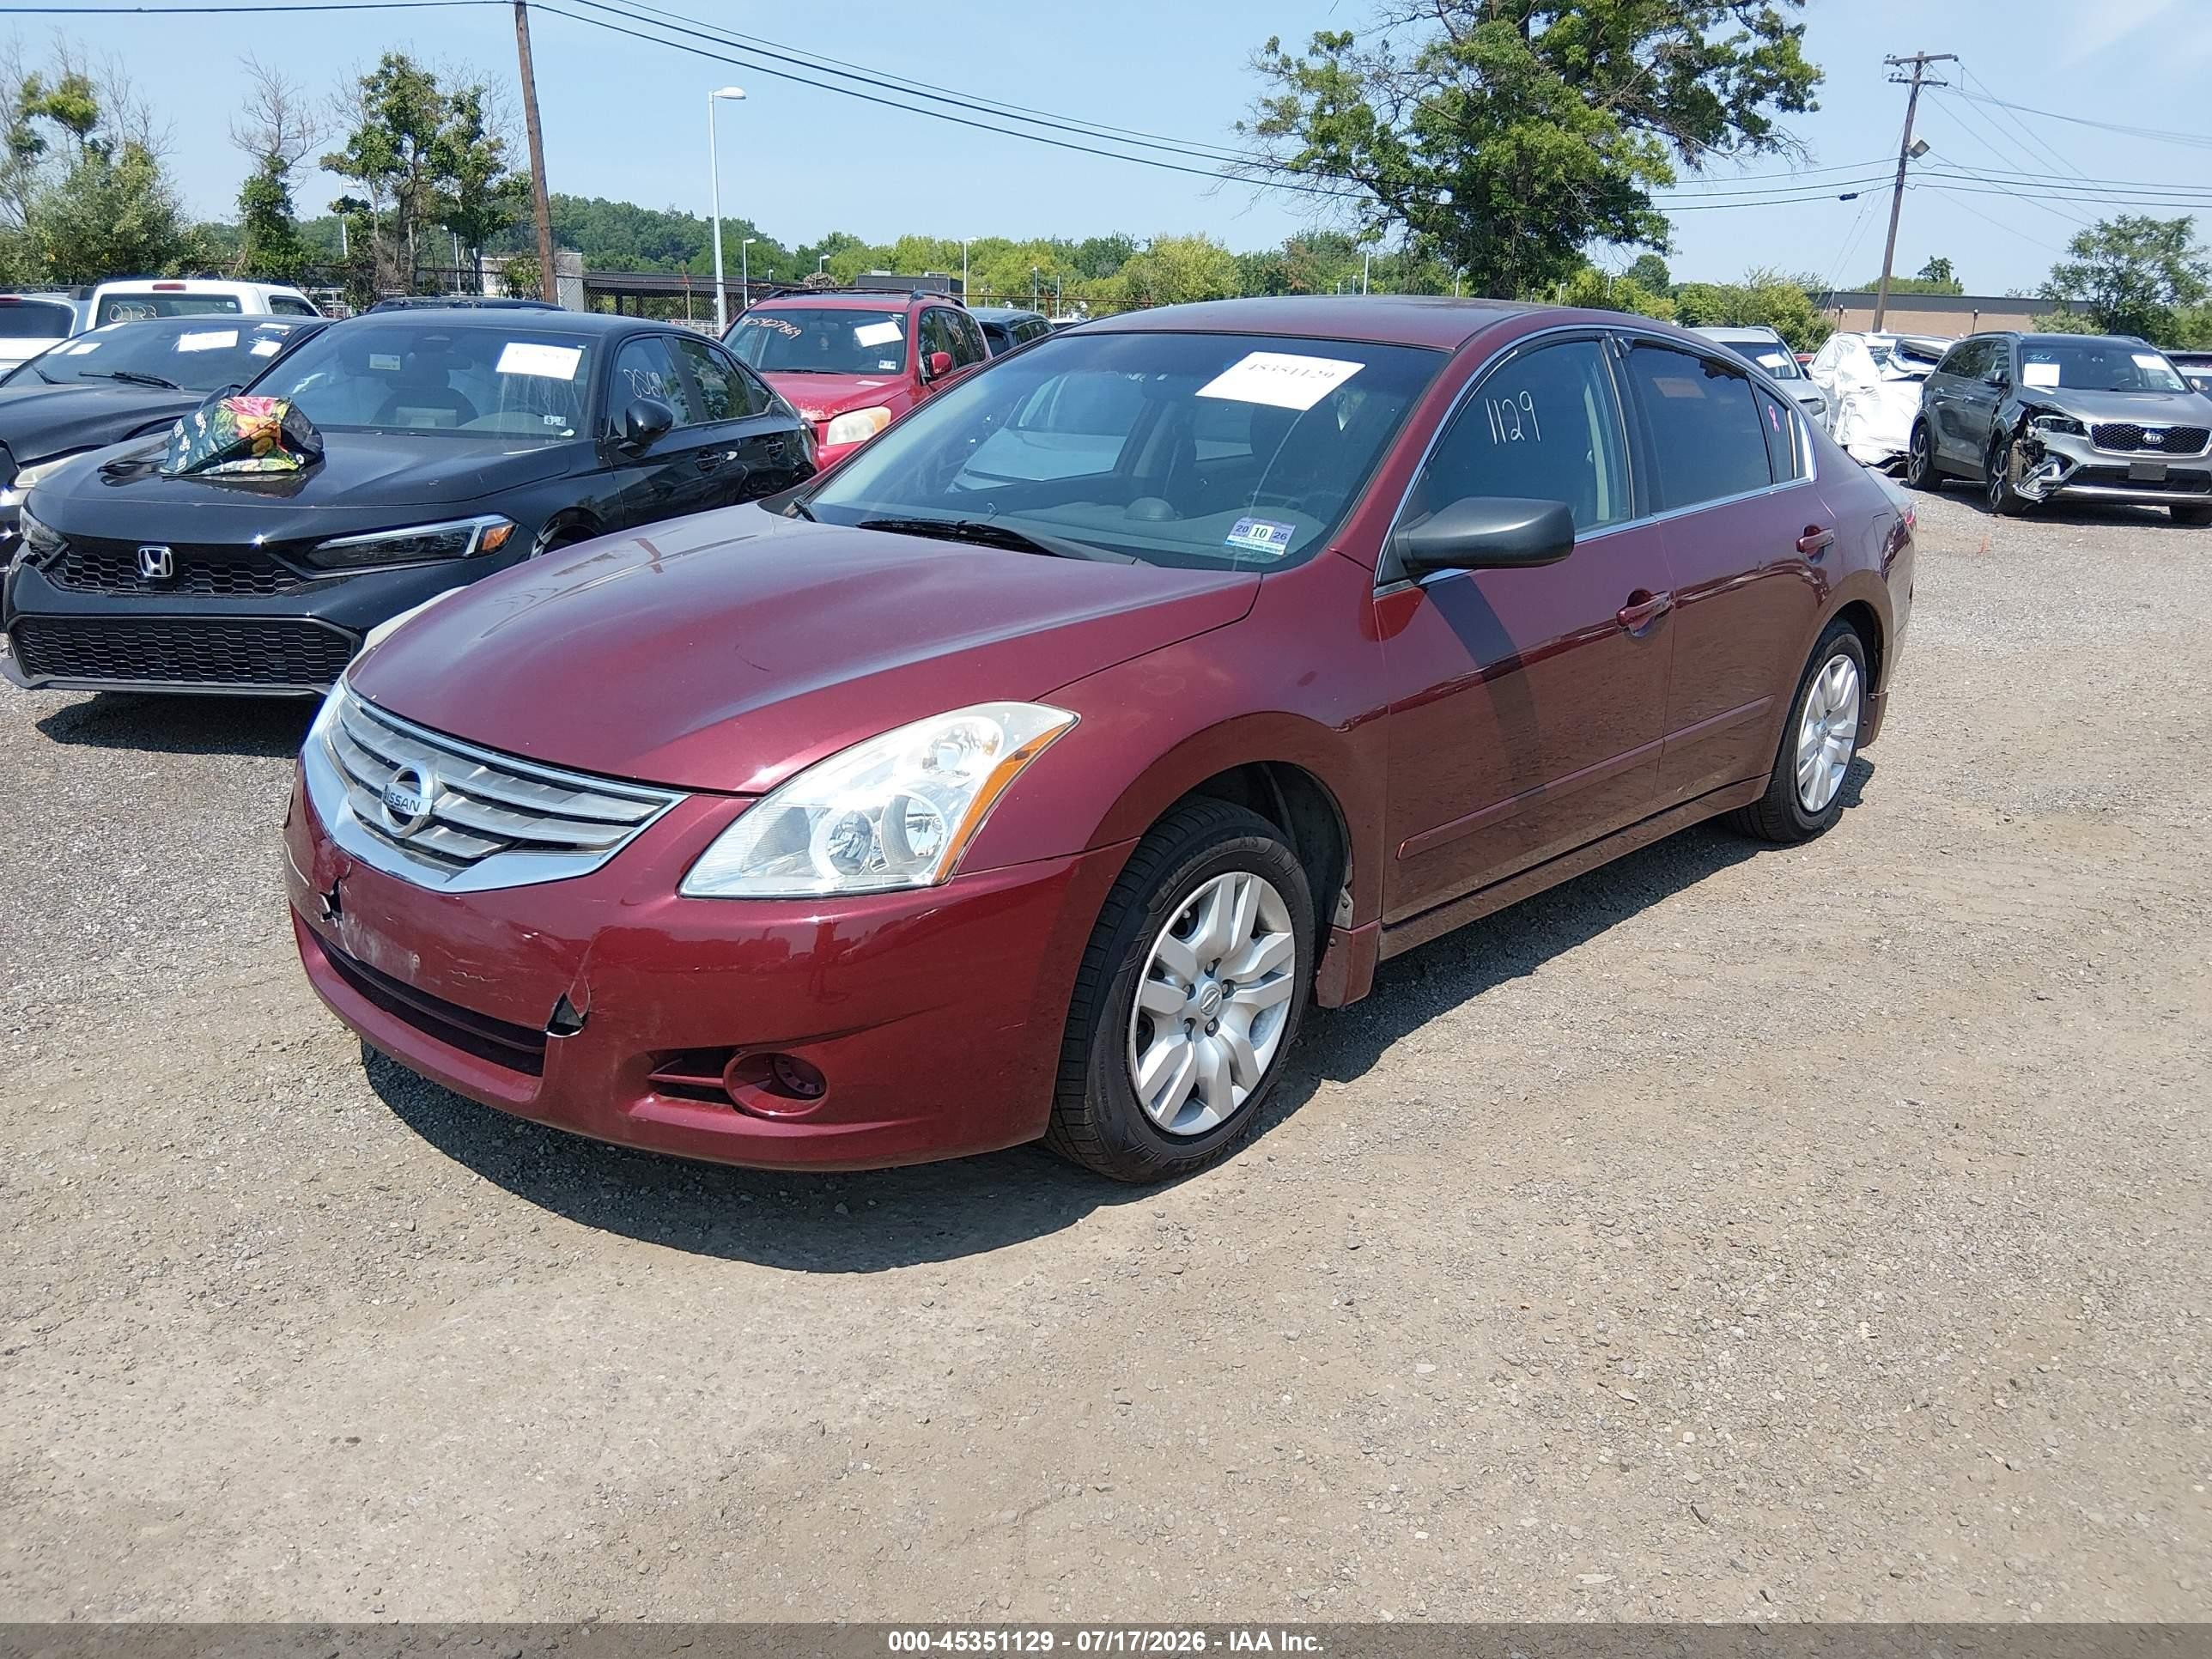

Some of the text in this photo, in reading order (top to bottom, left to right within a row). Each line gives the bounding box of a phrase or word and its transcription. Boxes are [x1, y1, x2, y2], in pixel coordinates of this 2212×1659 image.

[1485, 390, 1541, 445] 1129
[1235, 524, 1249, 534] 20
[1251, 526, 1268, 538] 10
[1273, 531, 1288, 541] 26
[384, 784, 421, 812] NISSAN
